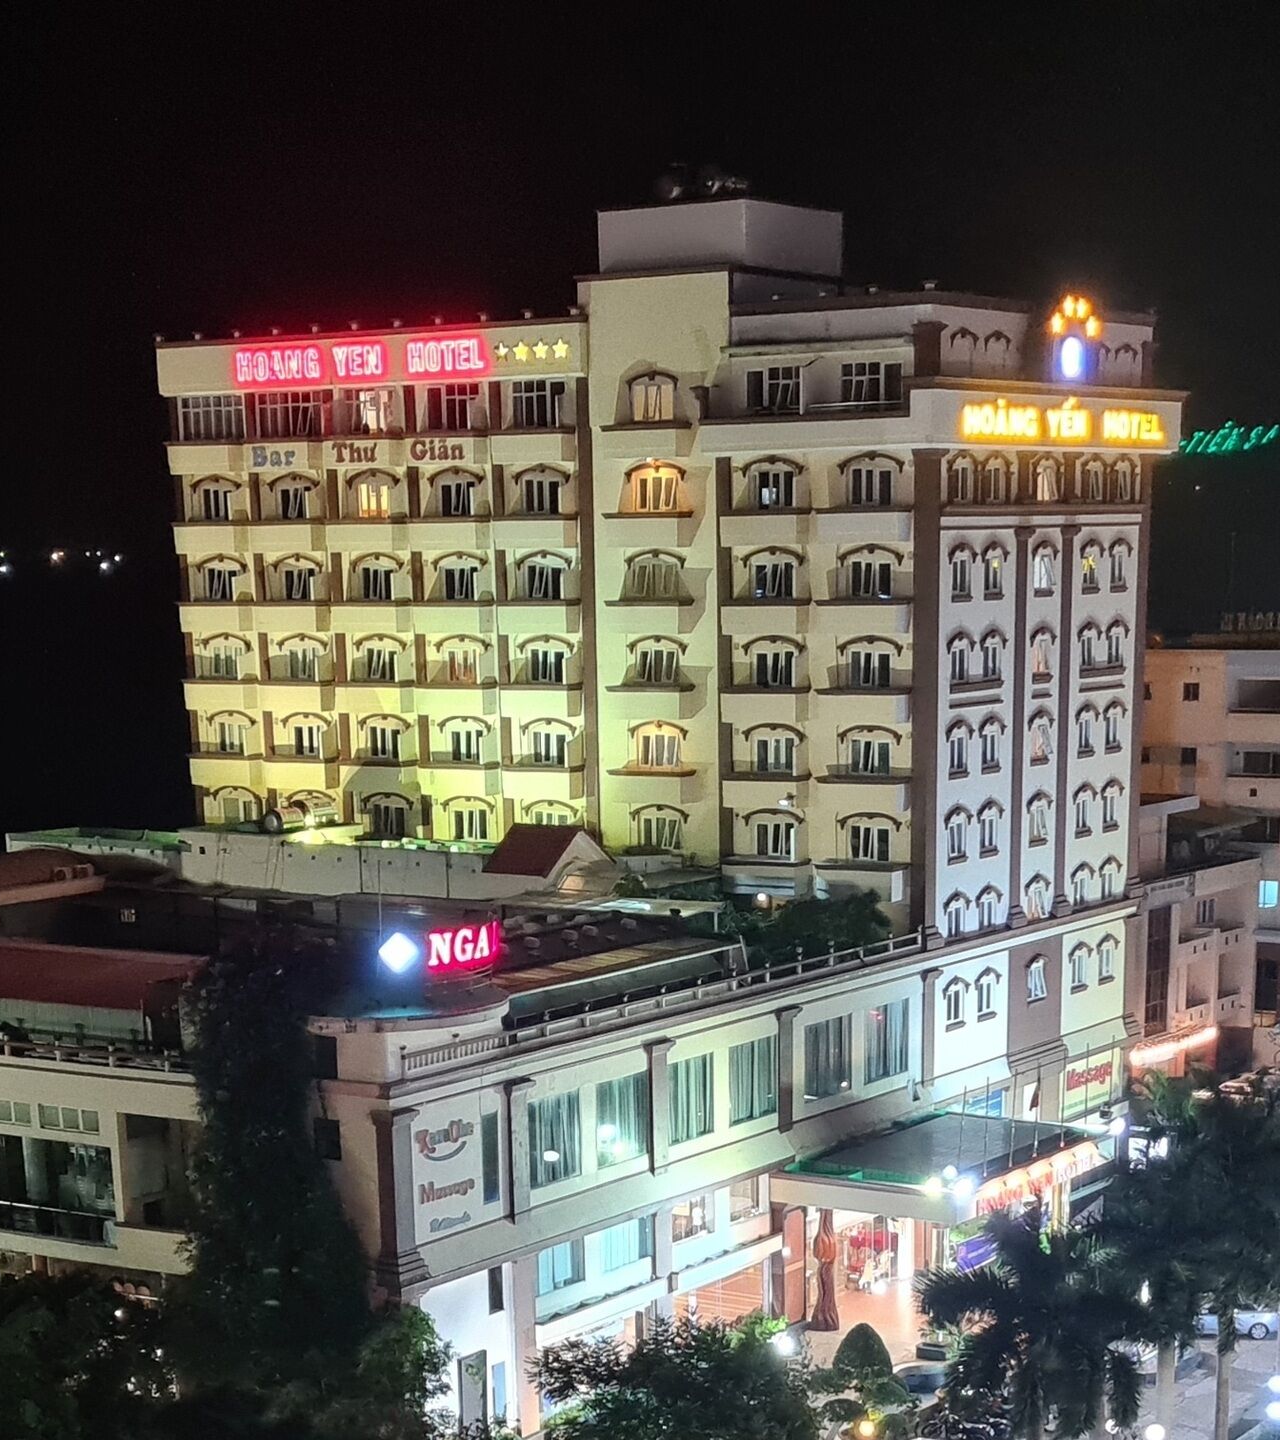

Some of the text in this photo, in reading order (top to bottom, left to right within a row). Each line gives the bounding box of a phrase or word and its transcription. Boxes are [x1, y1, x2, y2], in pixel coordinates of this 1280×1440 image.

[235, 338, 485, 382] HOANG YEN HOTEL
[1102, 409, 1164, 440] HOTEL
[251, 438, 465, 468] Bar Thư Giãn
